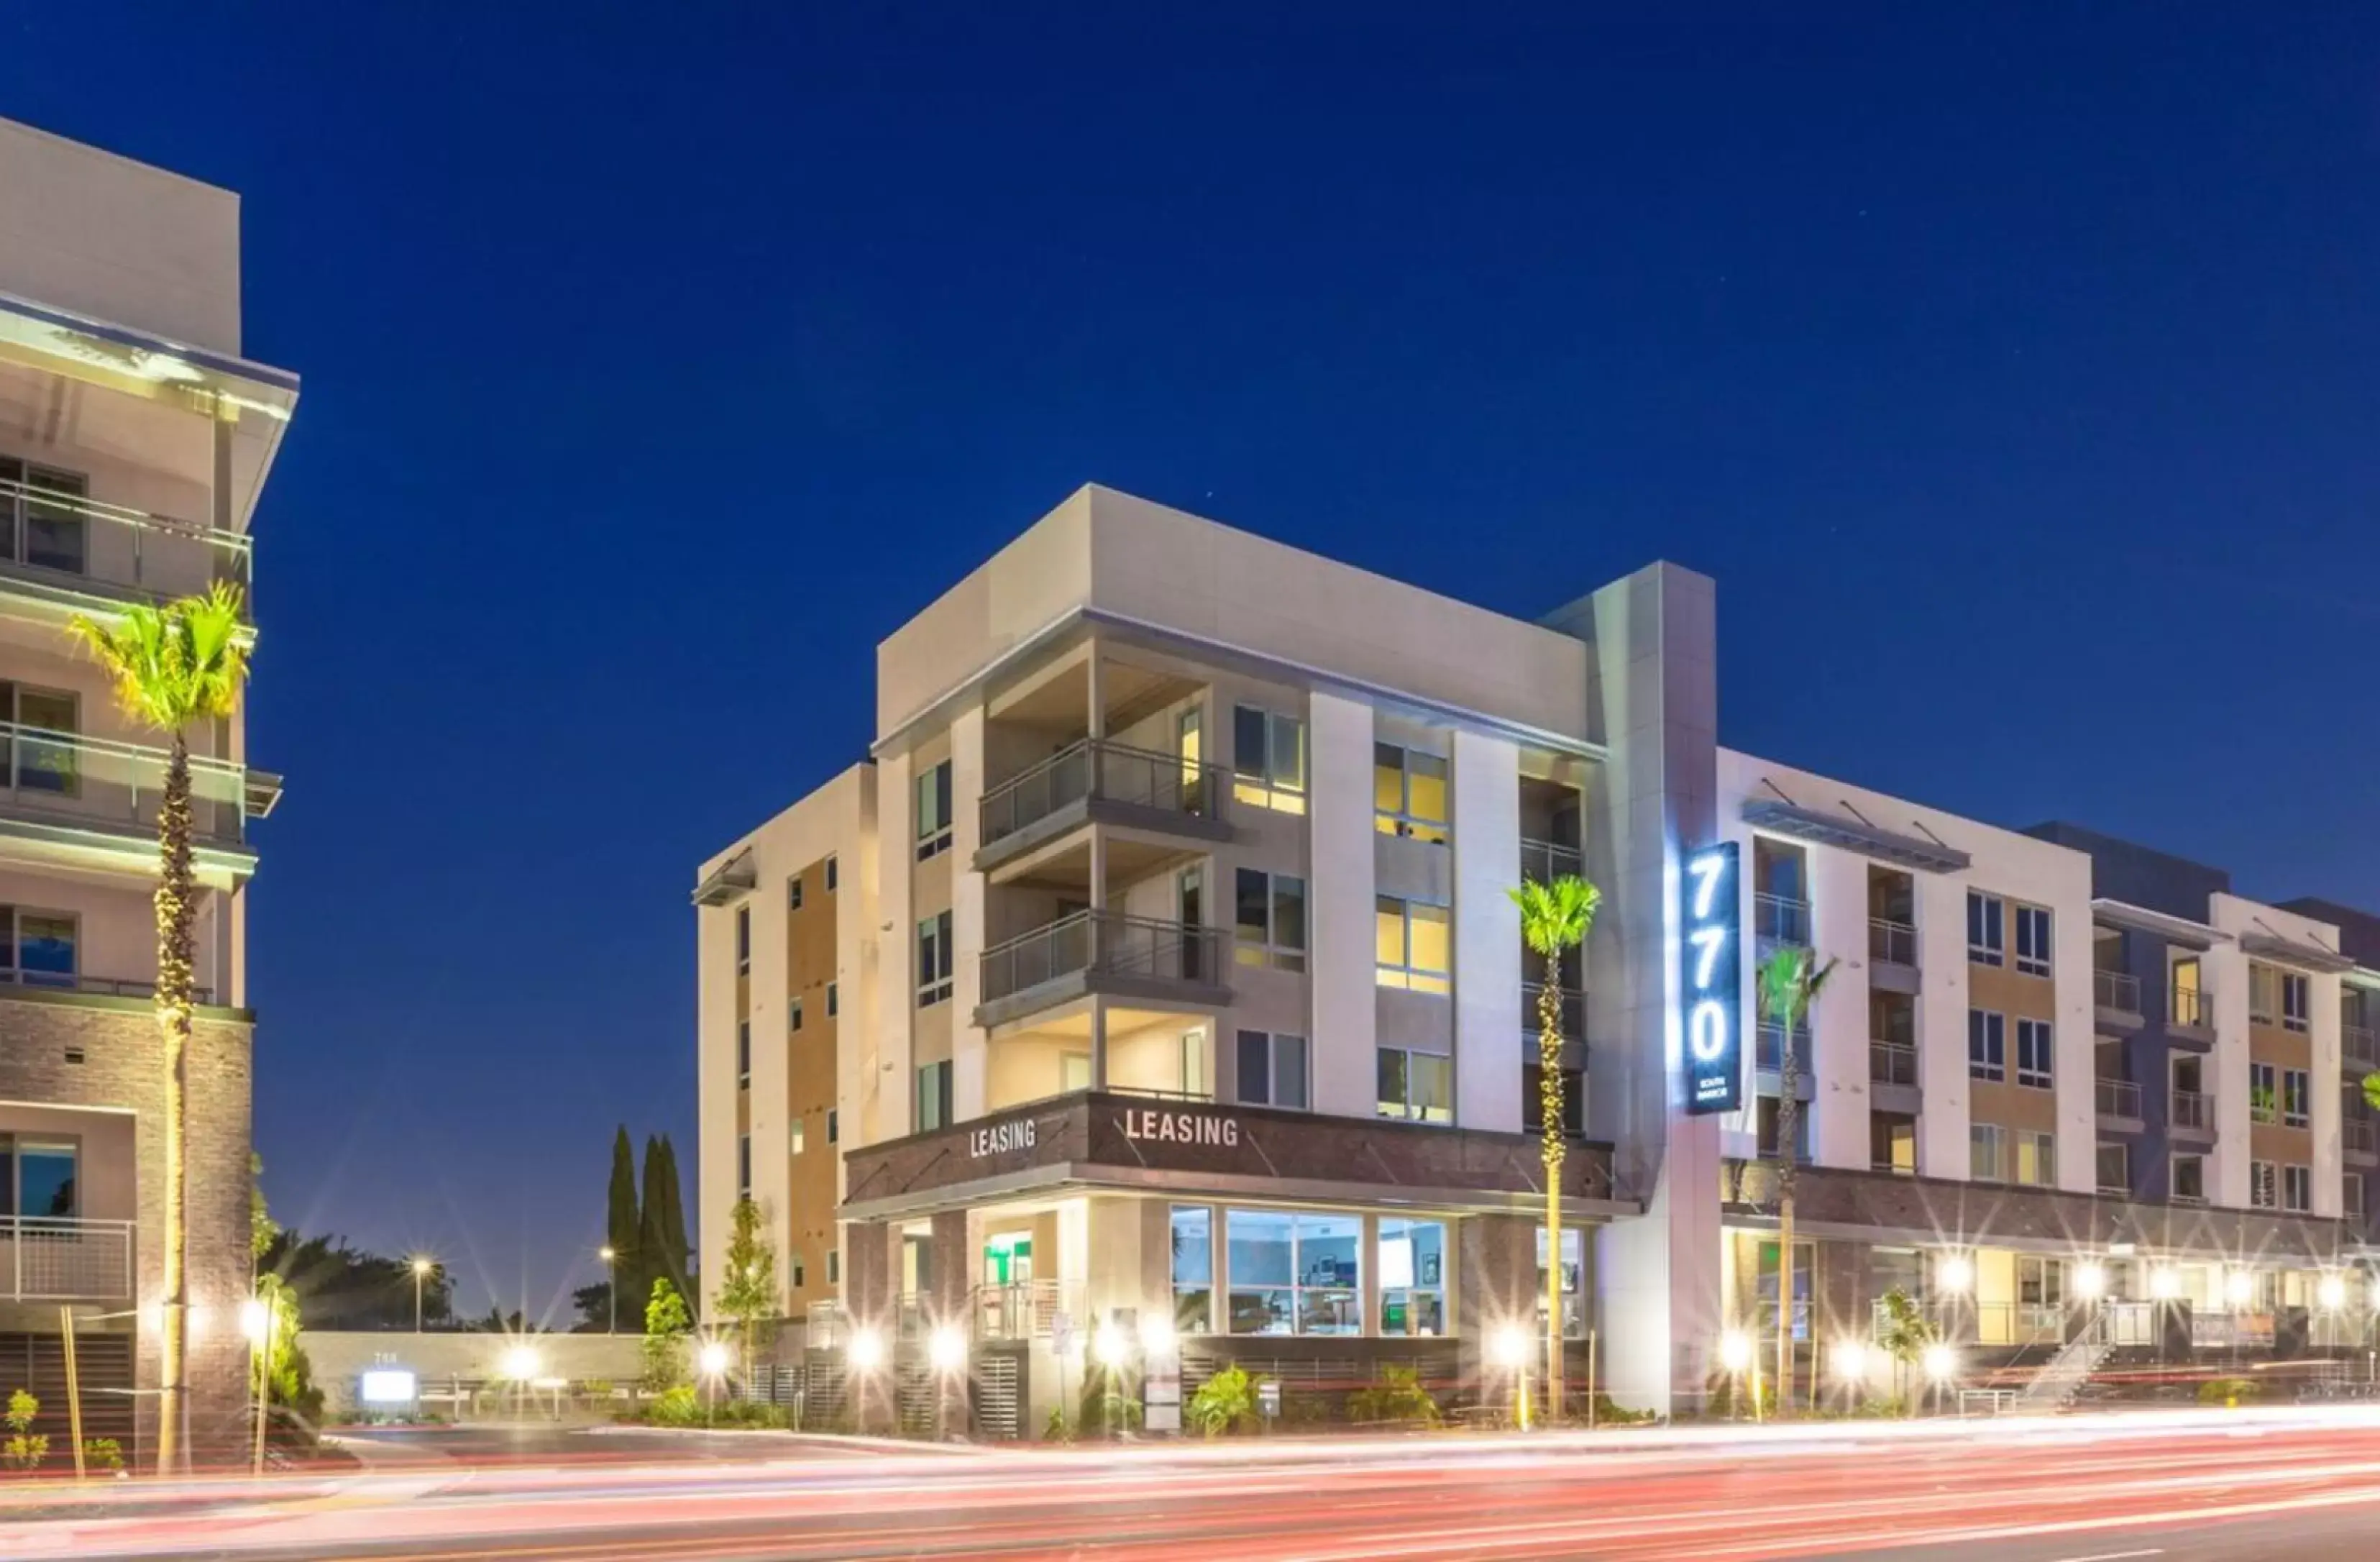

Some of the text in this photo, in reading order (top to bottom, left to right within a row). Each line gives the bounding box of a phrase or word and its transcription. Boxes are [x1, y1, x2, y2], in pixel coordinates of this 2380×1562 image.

[1690, 854, 1726, 1061] 770
[970, 1120, 1035, 1158] LEASING
[1126, 1109, 1238, 1146] LEASING
